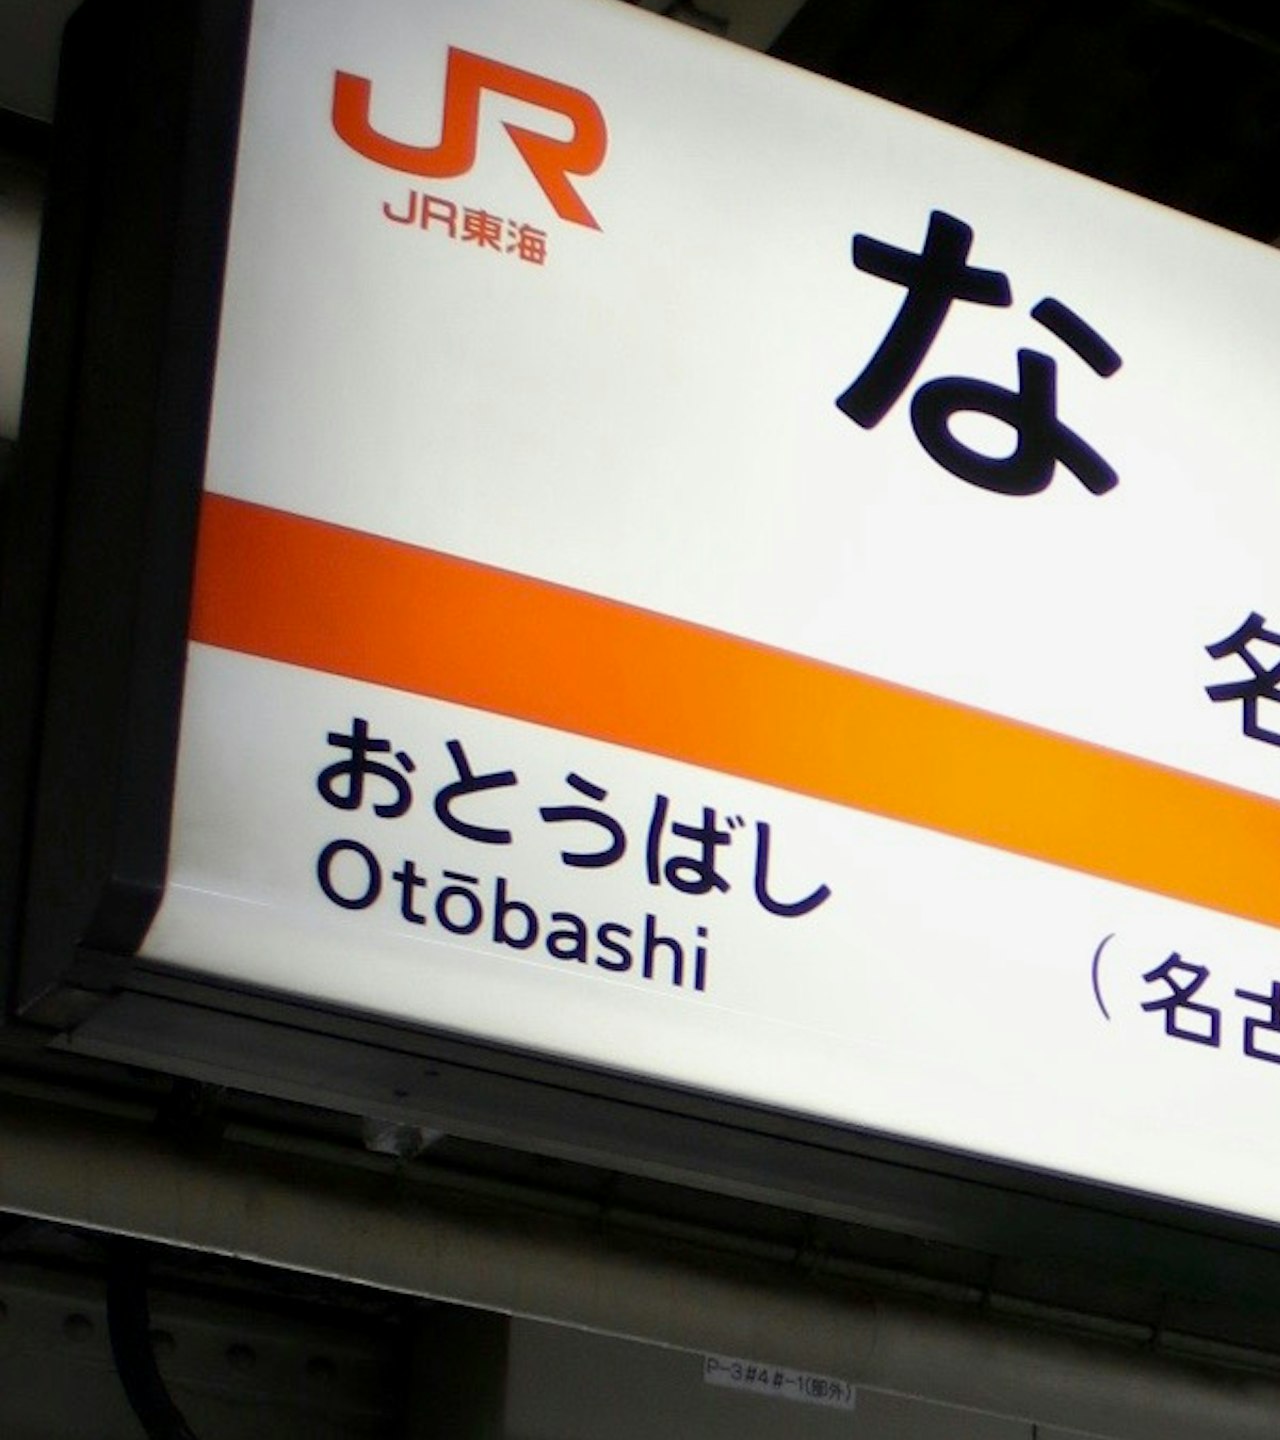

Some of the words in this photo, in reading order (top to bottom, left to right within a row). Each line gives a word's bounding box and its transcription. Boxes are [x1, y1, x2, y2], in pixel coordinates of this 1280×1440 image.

[330, 44, 610, 234] JR
[384, 192, 548, 268] JR東海
[316, 714, 832, 920] おとうばし
[316, 839, 711, 994] Otōbashi
